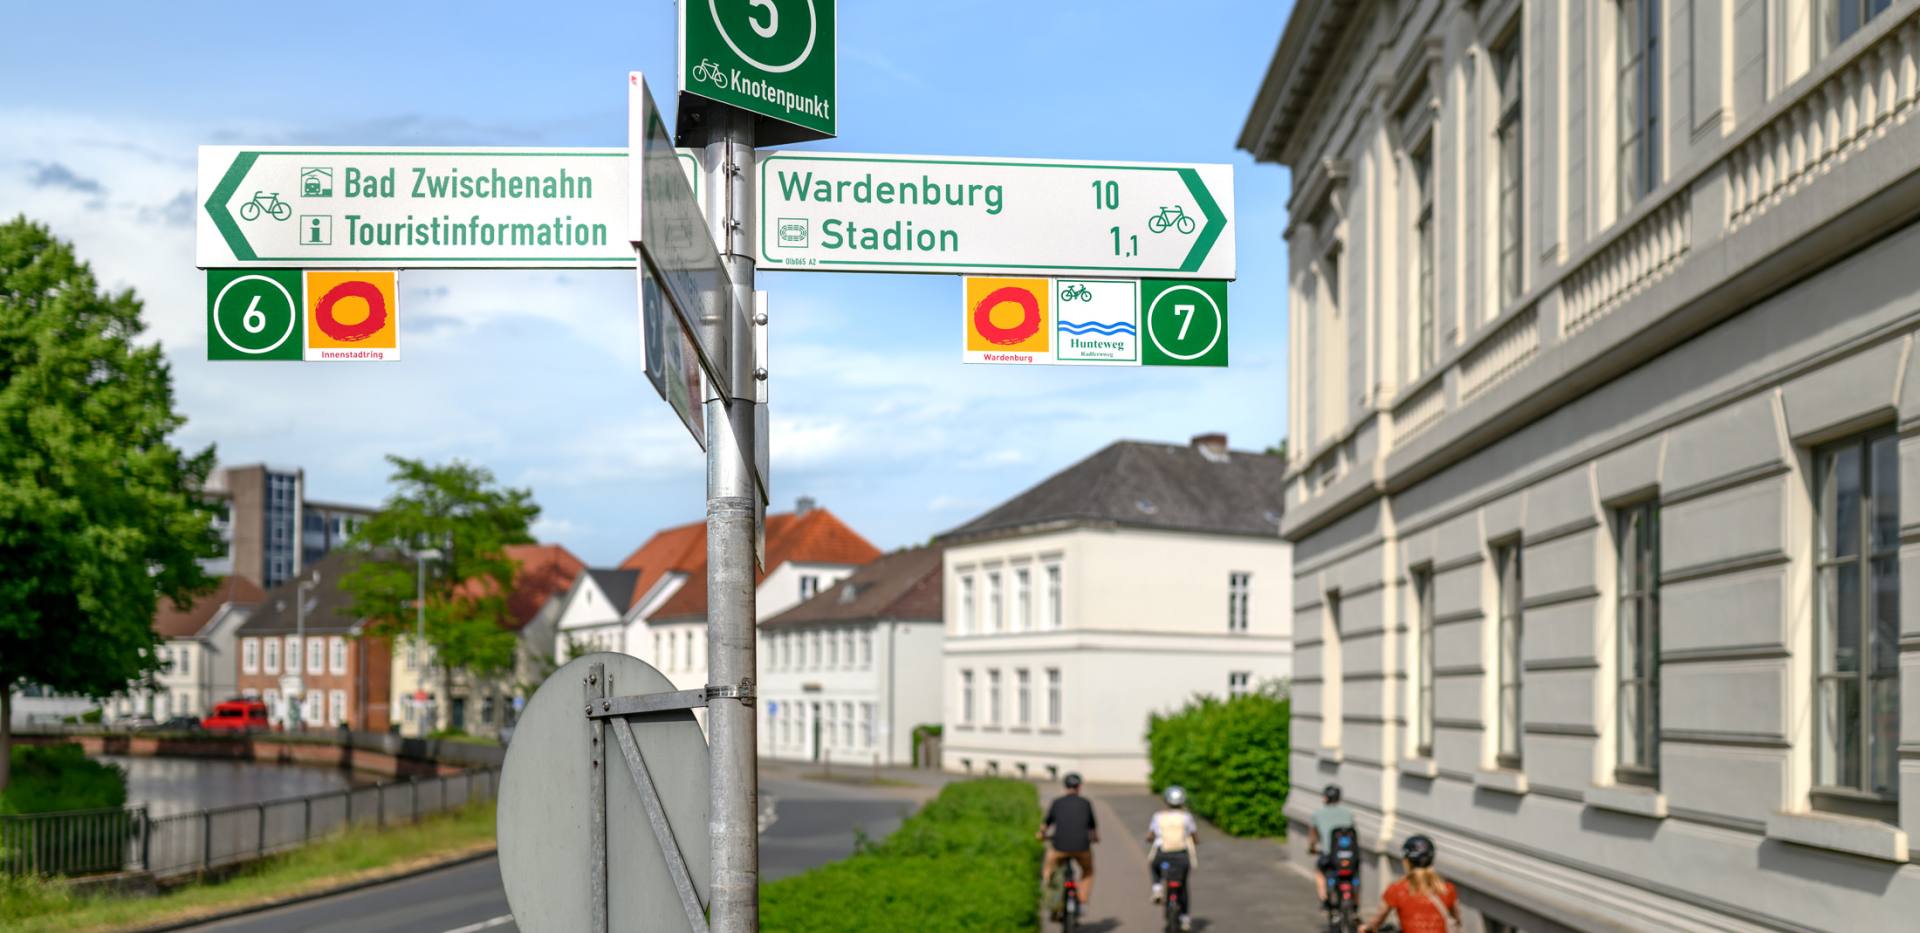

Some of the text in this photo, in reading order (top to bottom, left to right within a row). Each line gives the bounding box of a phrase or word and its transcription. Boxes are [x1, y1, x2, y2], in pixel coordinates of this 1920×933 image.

[748, 0, 779, 38] 5
[730, 68, 830, 120] Knotenpunkt
[344, 167, 592, 199] Bad Zwischenahn
[778, 170, 1120, 215] Wardenburg 10
[344, 214, 607, 246] Touristinformation
[821, 219, 1138, 258] Stadion 1,1
[242, 295, 266, 334] 6
[1174, 304, 1195, 341] 7
[321, 351, 384, 360] Innenstadtring
[983, 353, 1033, 363] Wardenburg
[1070, 338, 1125, 352] Hunteweg
